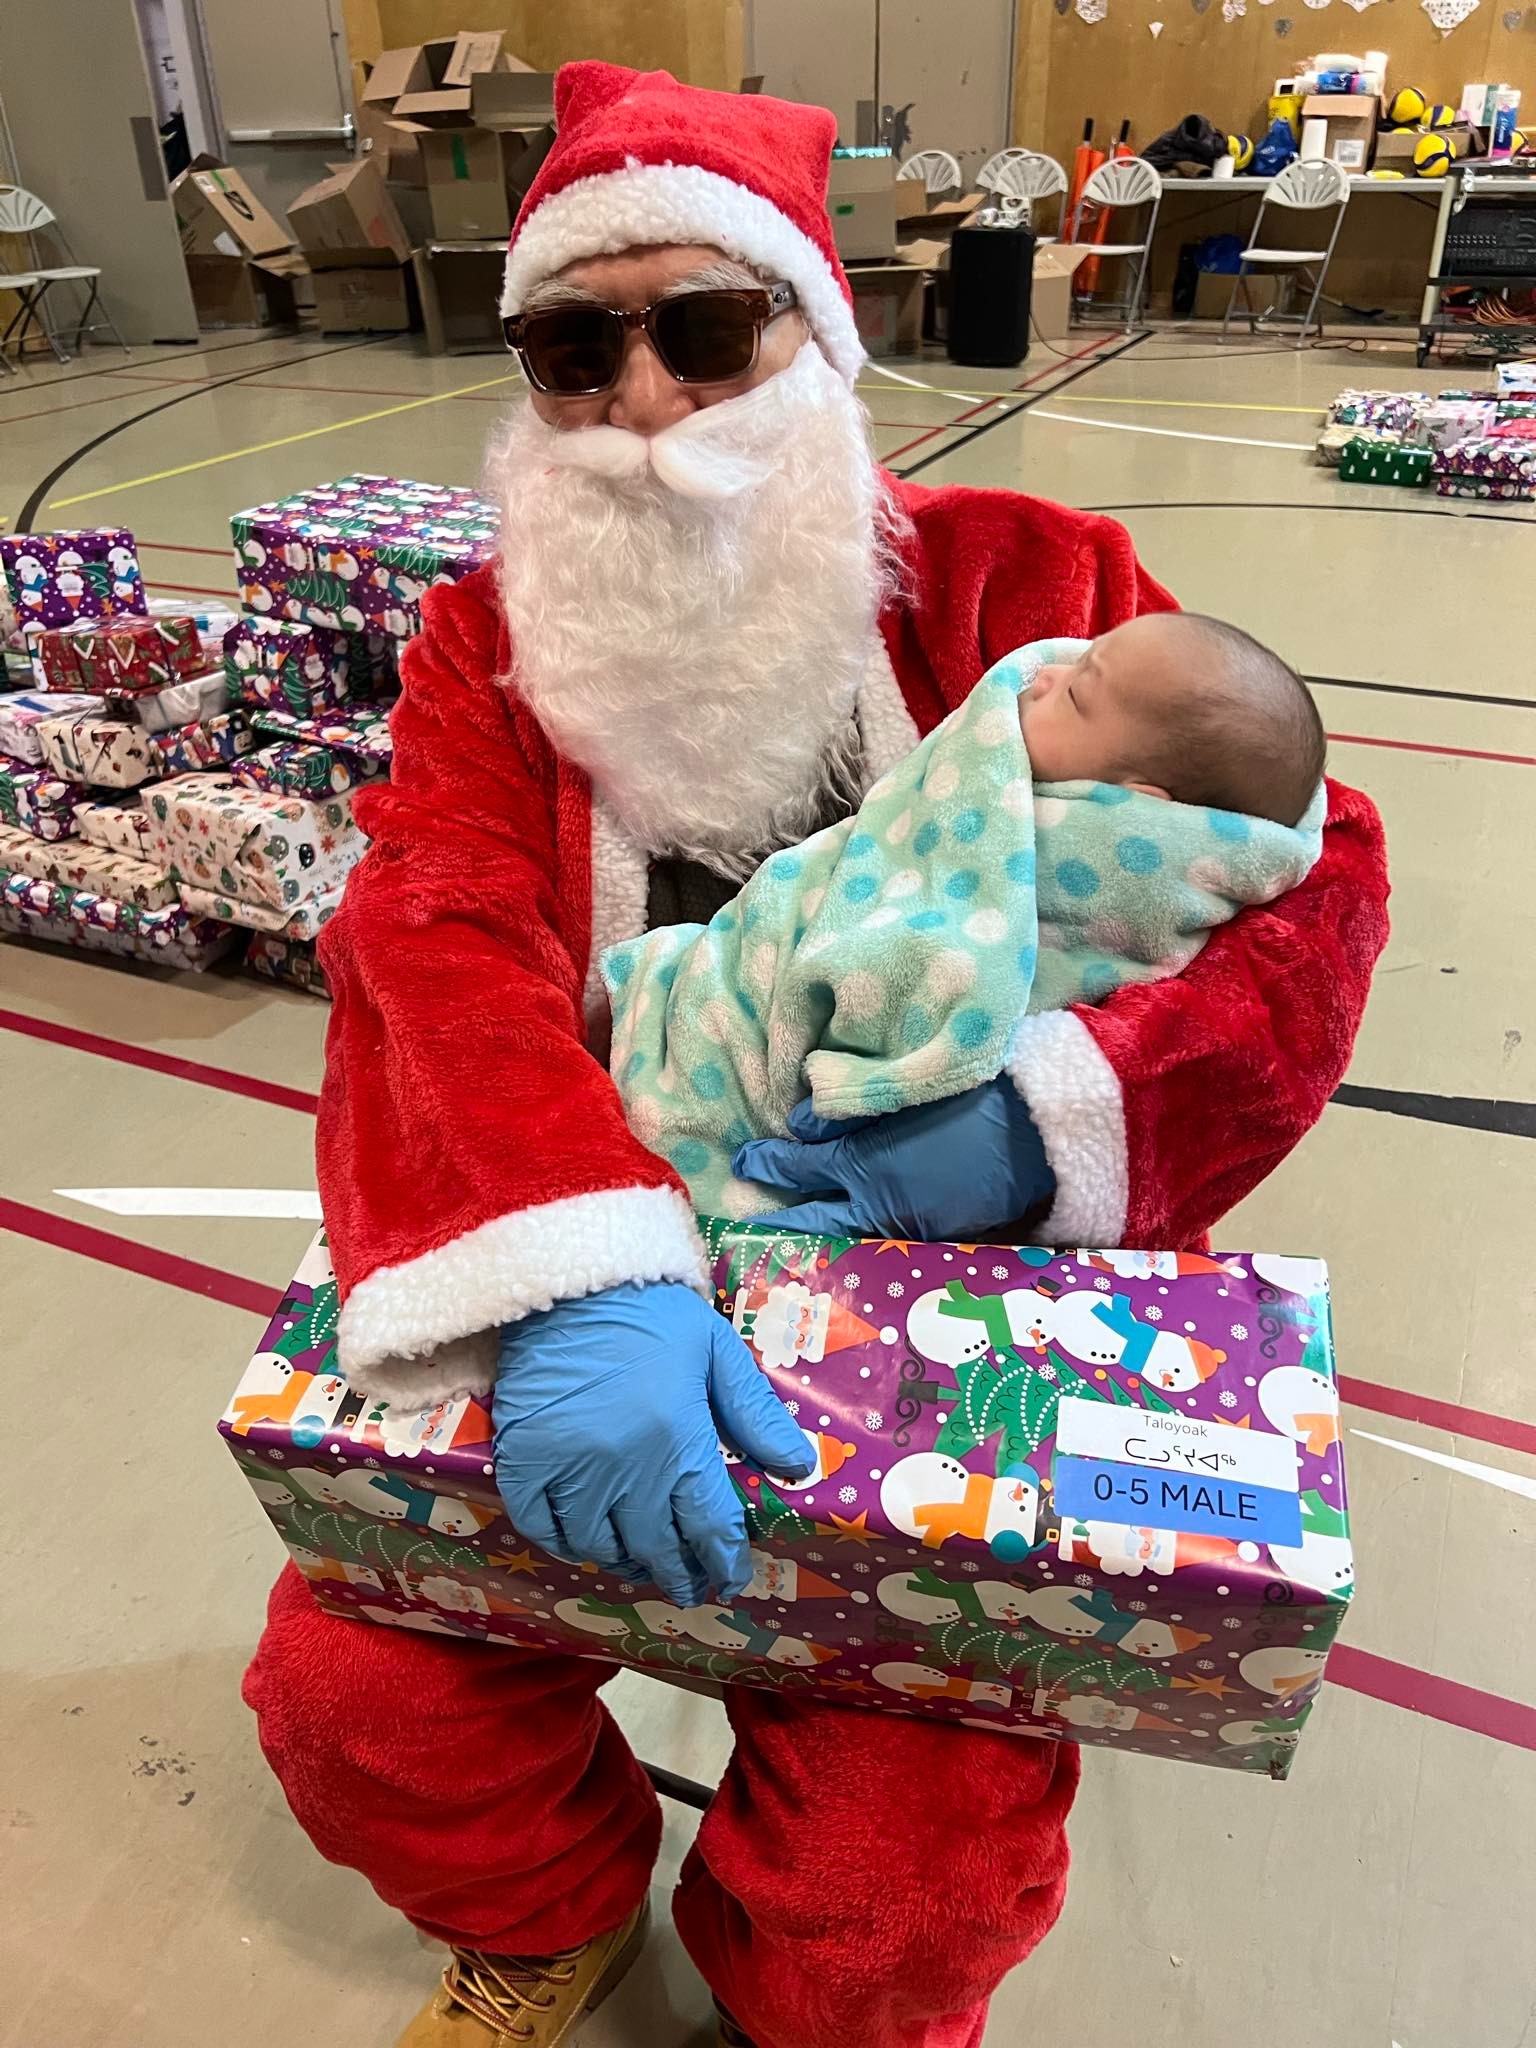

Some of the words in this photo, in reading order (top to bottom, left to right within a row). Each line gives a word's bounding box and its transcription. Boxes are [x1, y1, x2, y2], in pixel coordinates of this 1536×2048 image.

[1143, 1414, 1208, 1438] Taloyoak
[1094, 1474, 1149, 1505] 0-5
[1162, 1482, 1258, 1521] MALE
